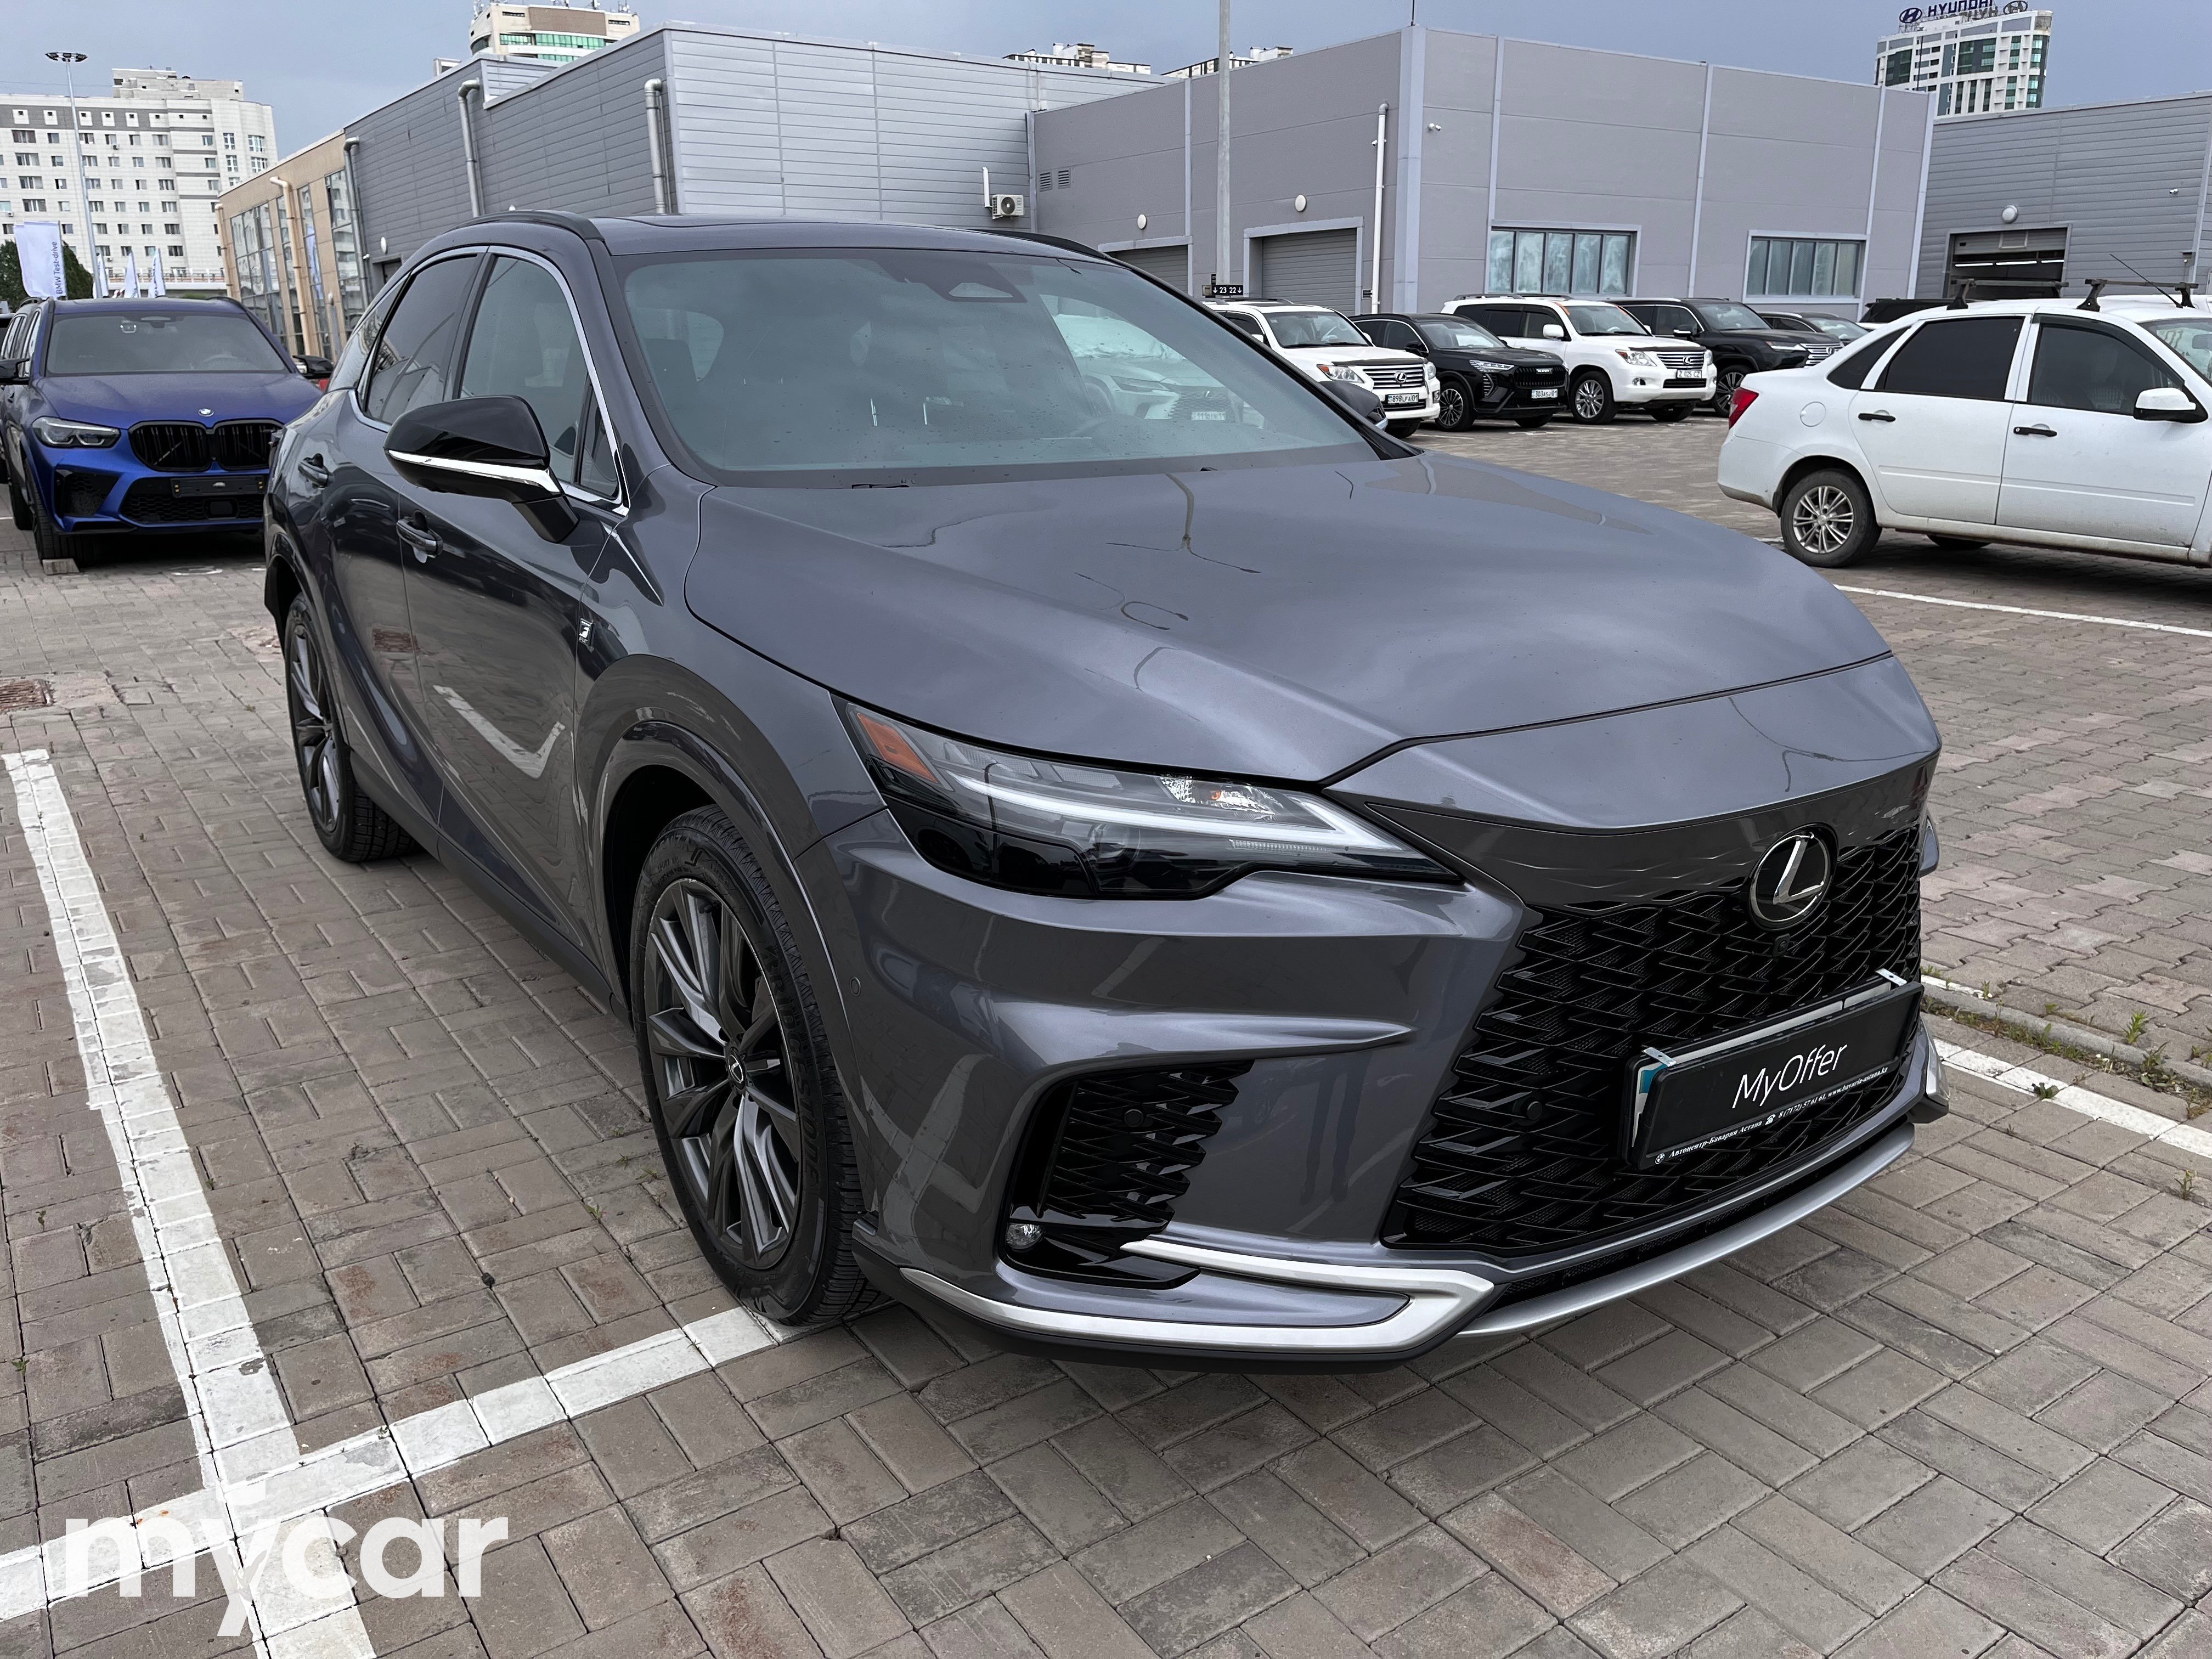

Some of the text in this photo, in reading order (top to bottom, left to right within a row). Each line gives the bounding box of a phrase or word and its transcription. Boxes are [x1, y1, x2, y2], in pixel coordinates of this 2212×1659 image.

[1928, 0, 1993, 17] HYUNDAI
[52, 241, 63, 295] BMW Test-drive
[761, 945, 819, 1187] BRIDGESTONE
[1732, 1044, 1848, 1109] MyOffer
[1739, 1120, 1763, 1134] Астана
[1778, 1110, 1784, 1119] 8
[1782, 1103, 1802, 1118] (7172)
[1802, 1100, 1811, 1109] 57
[1810, 1096, 1818, 1105] 61
